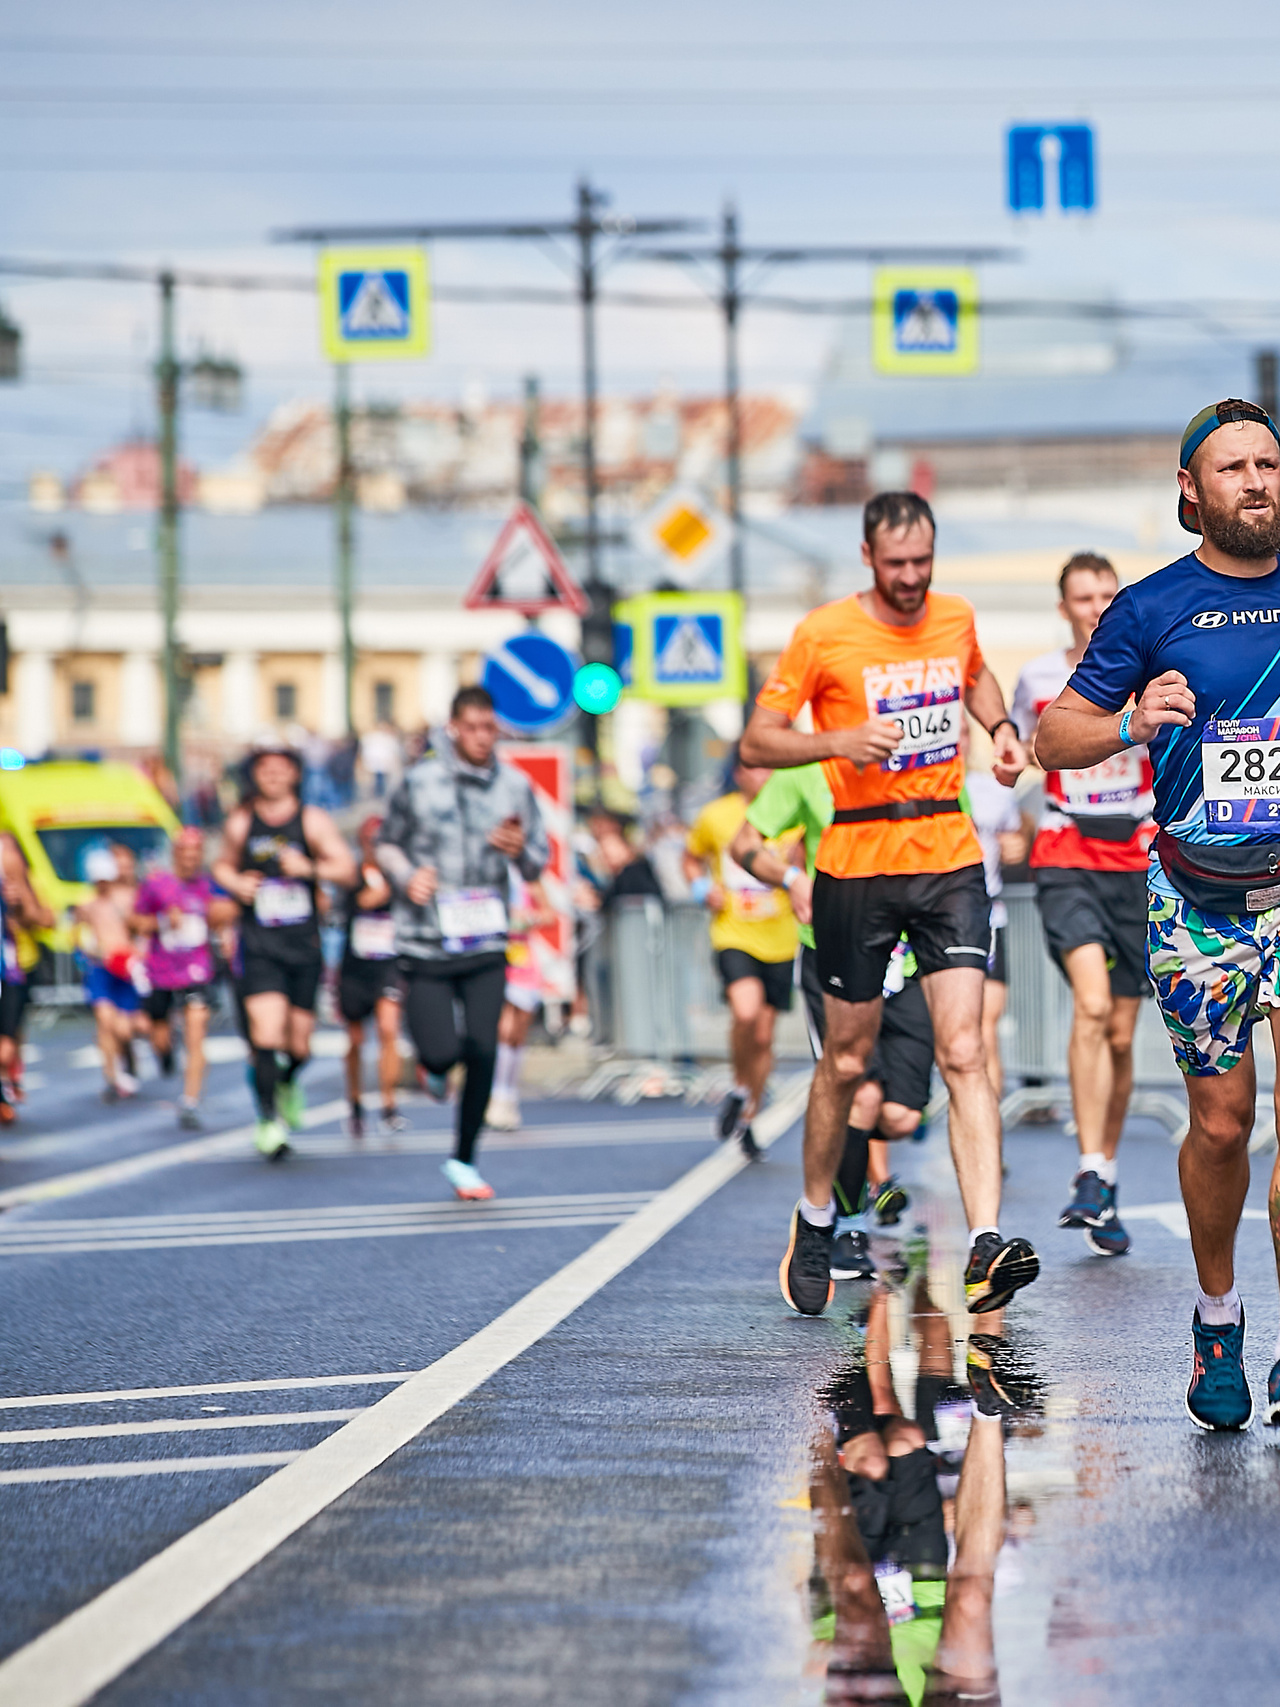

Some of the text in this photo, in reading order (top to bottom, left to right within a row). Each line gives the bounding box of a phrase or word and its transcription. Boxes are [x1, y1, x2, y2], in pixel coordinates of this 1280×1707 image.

[1217, 719, 1240, 728] ПОЛУ
[1217, 726, 1260, 735] МАРАФОН
[888, 755, 903, 772] C
[1217, 801, 1233, 822] D
